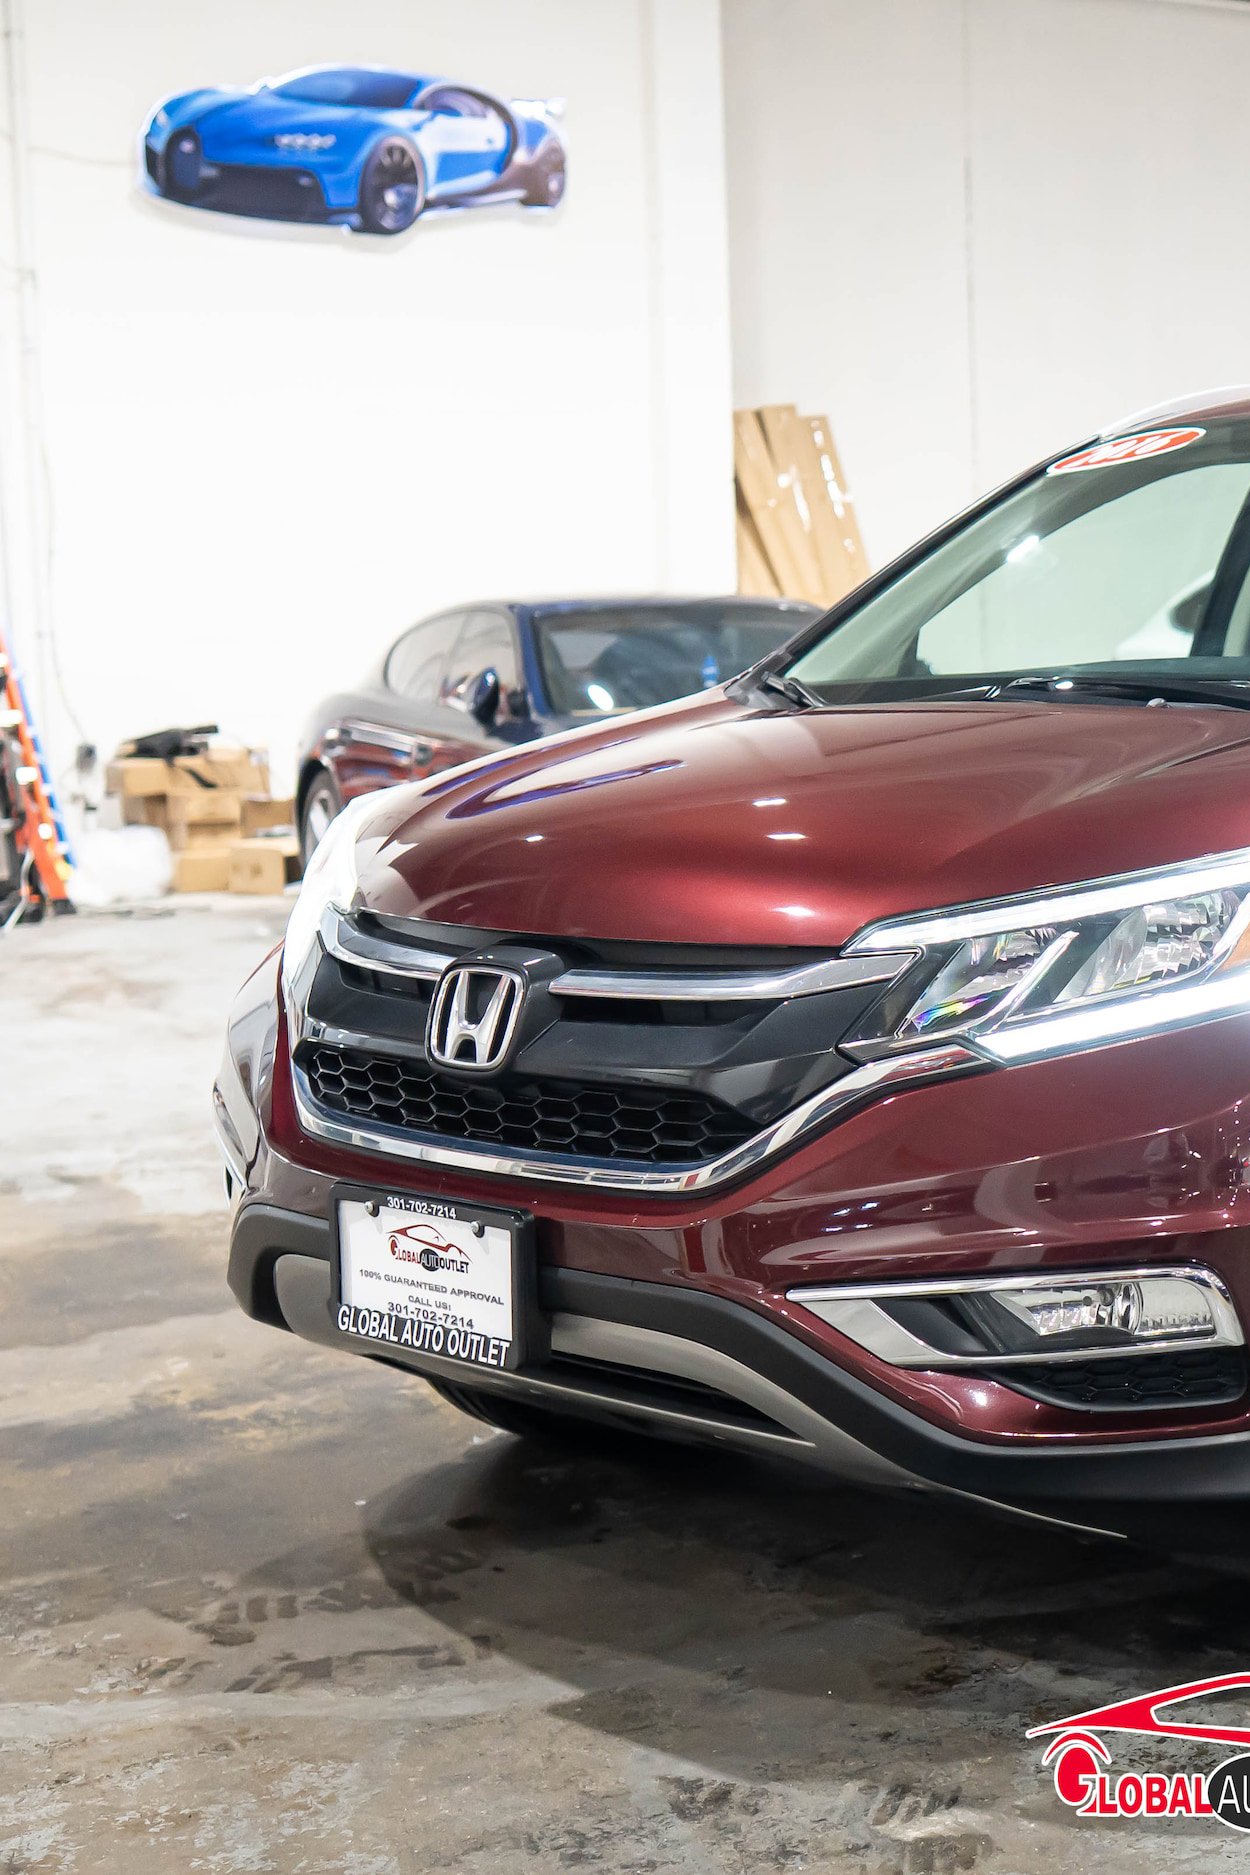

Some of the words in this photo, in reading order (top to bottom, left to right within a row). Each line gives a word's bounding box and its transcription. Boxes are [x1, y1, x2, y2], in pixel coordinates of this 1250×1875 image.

[387, 1196, 457, 1219] 301-702-7214
[390, 1238, 421, 1264] GLOBAL
[439, 1257, 469, 1274] OUTLET
[359, 1268, 382, 1281] 100%
[384, 1273, 448, 1294] GUARANTEED
[450, 1287, 504, 1306] APPROVAL
[408, 1295, 432, 1307] CALL
[434, 1300, 452, 1311] US:
[387, 1301, 474, 1330] 301-702-7214
[337, 1304, 398, 1342] GLOBAL
[401, 1323, 444, 1352] AUTO
[447, 1329, 511, 1367] OUTLET
